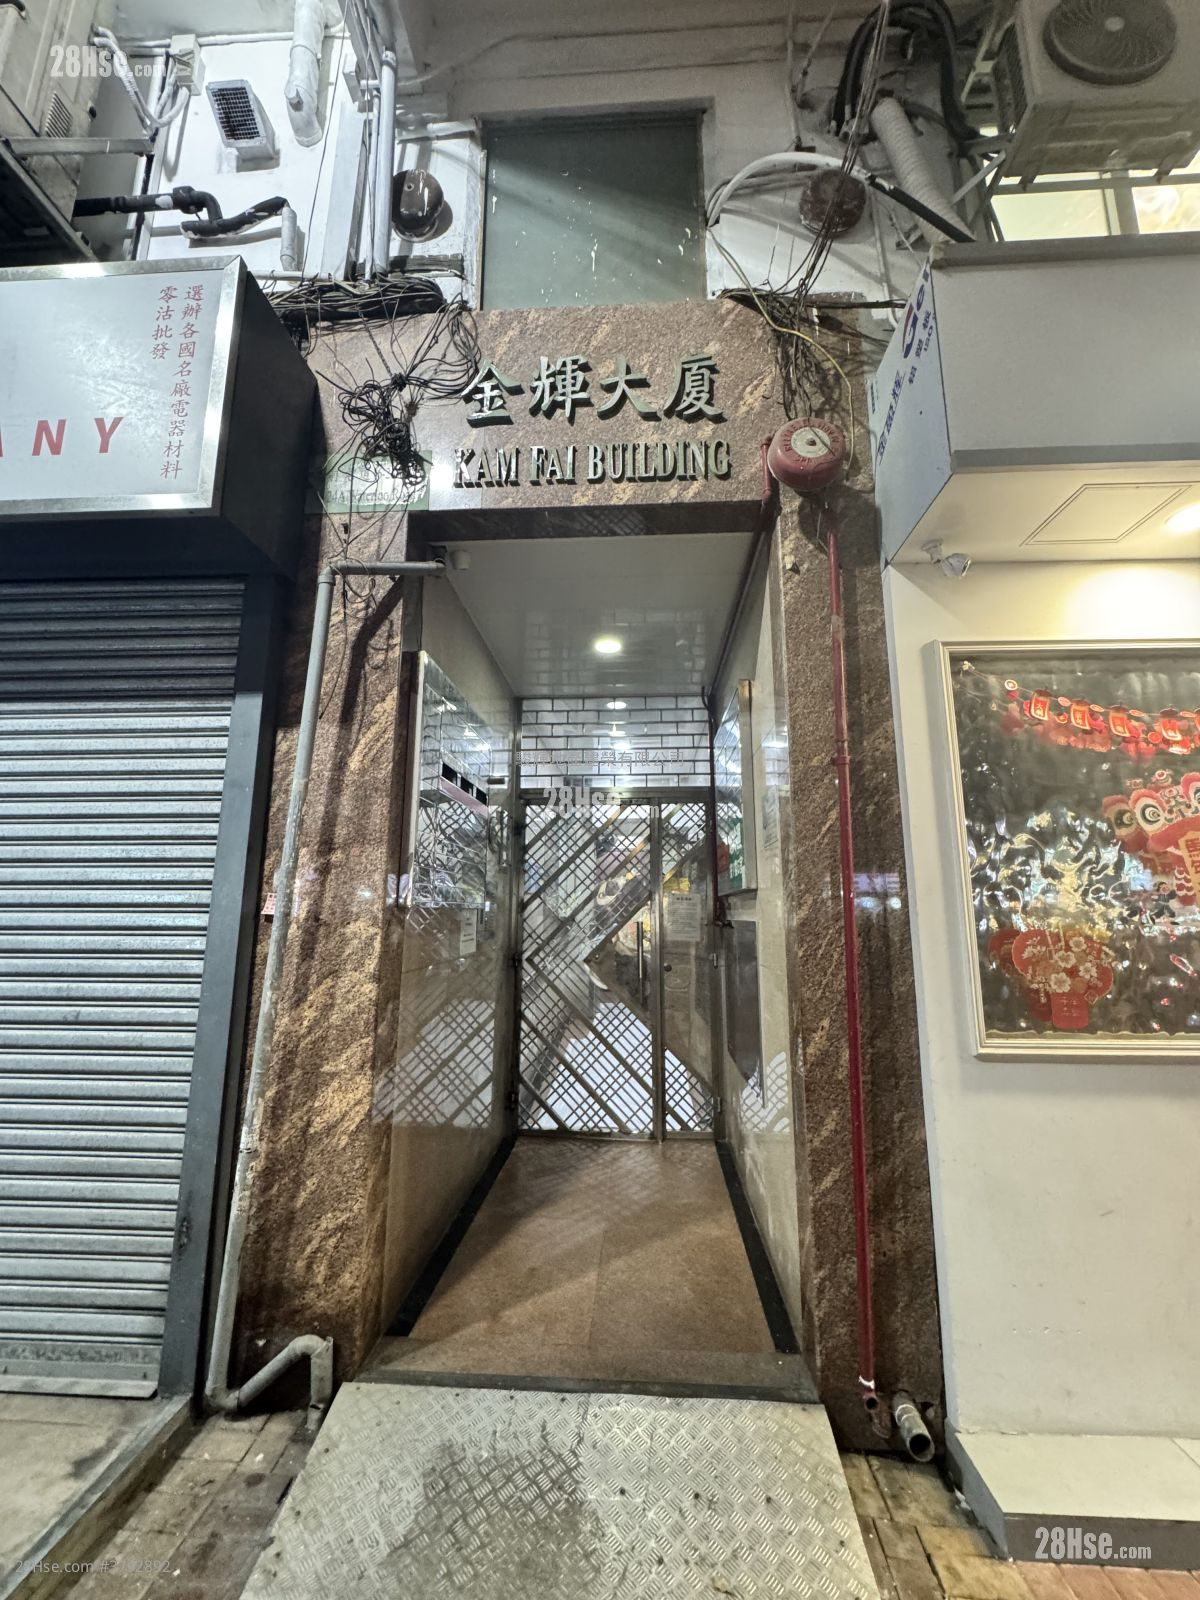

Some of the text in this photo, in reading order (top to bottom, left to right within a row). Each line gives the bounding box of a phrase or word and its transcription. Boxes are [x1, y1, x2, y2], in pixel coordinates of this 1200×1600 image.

[150, 285, 178, 360] 零沽批發
[160, 284, 204, 480] 選辦各國名廠電器材料
[461, 354, 726, 426] 金輝大廈
[0, 416, 124, 457] NY
[453, 447, 520, 488] KAM
[530, 444, 577, 486] FAI
[587, 438, 731, 484] BUILDING
